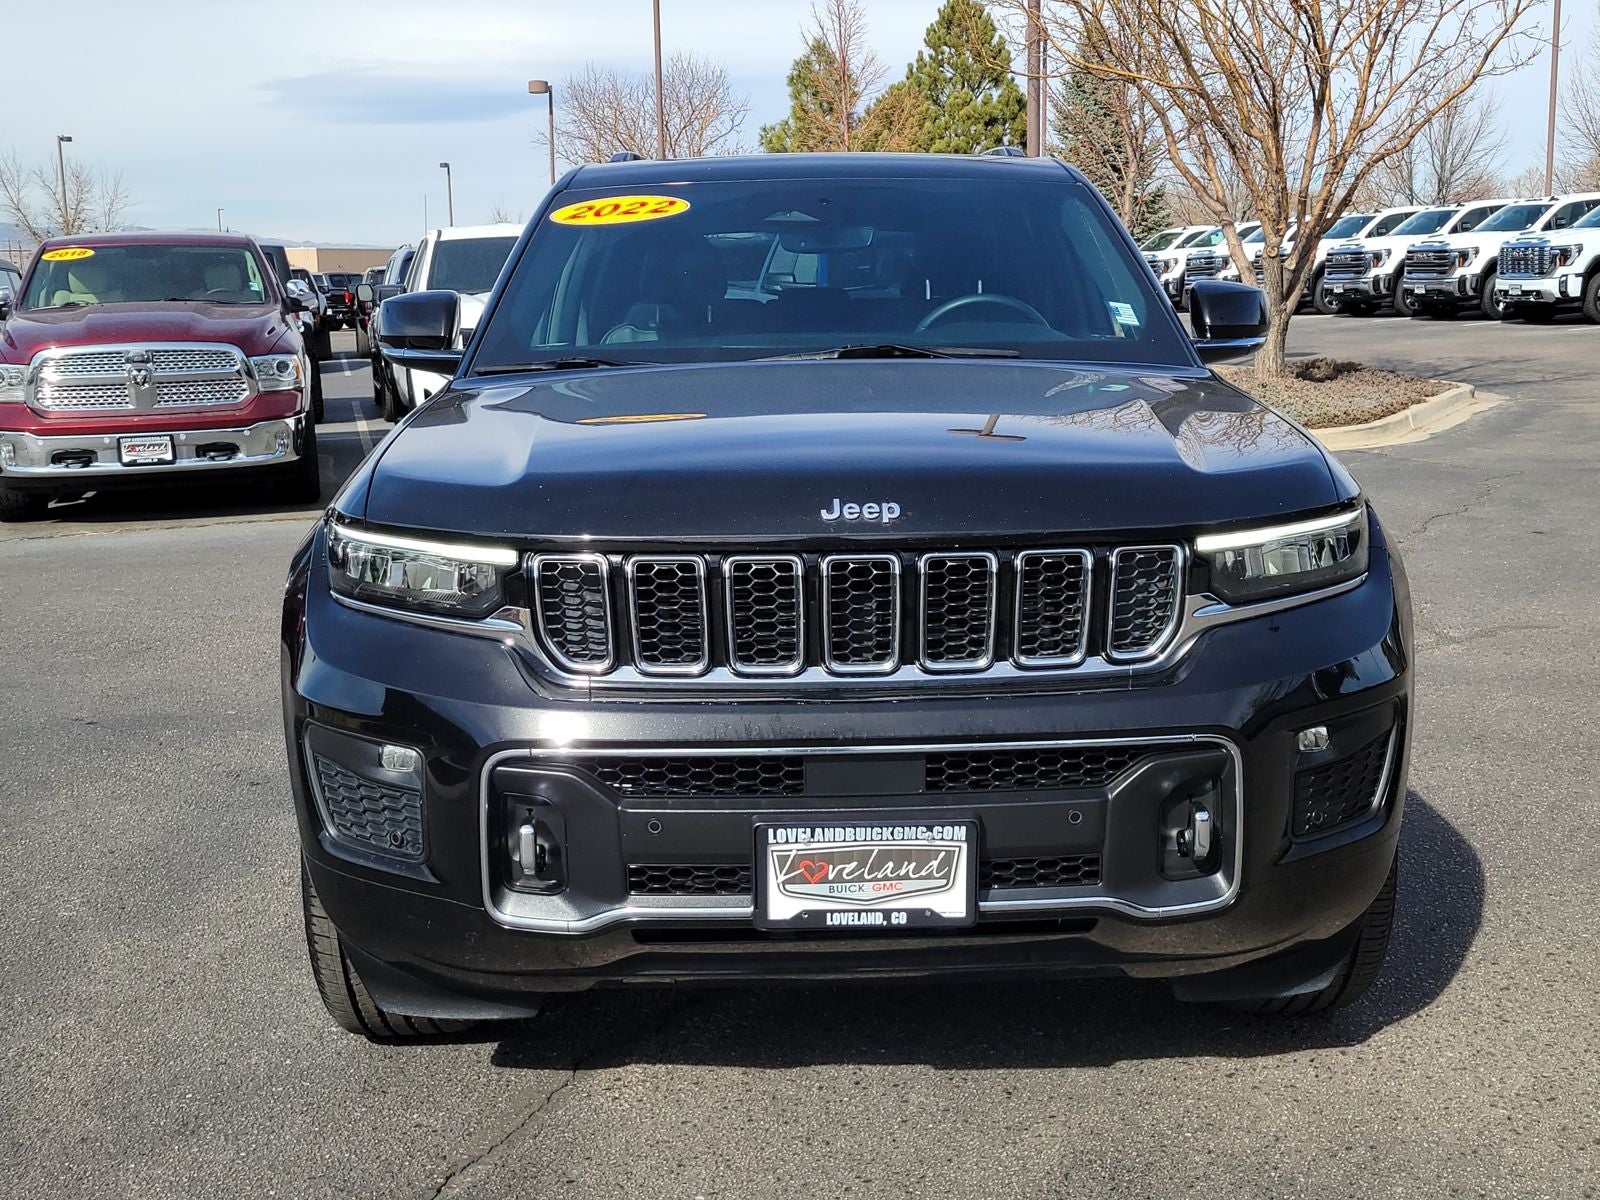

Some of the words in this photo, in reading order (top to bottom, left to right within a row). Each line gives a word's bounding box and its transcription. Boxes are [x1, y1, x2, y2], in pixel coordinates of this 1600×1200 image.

[563, 200, 677, 220] 2022
[48, 249, 88, 258] 2018
[820, 498, 901, 523] Jeep
[828, 884, 865, 894] BUICK
[872, 881, 904, 892] GMC
[826, 912, 887, 926] LOVELAND,
[891, 911, 907, 924] CO
